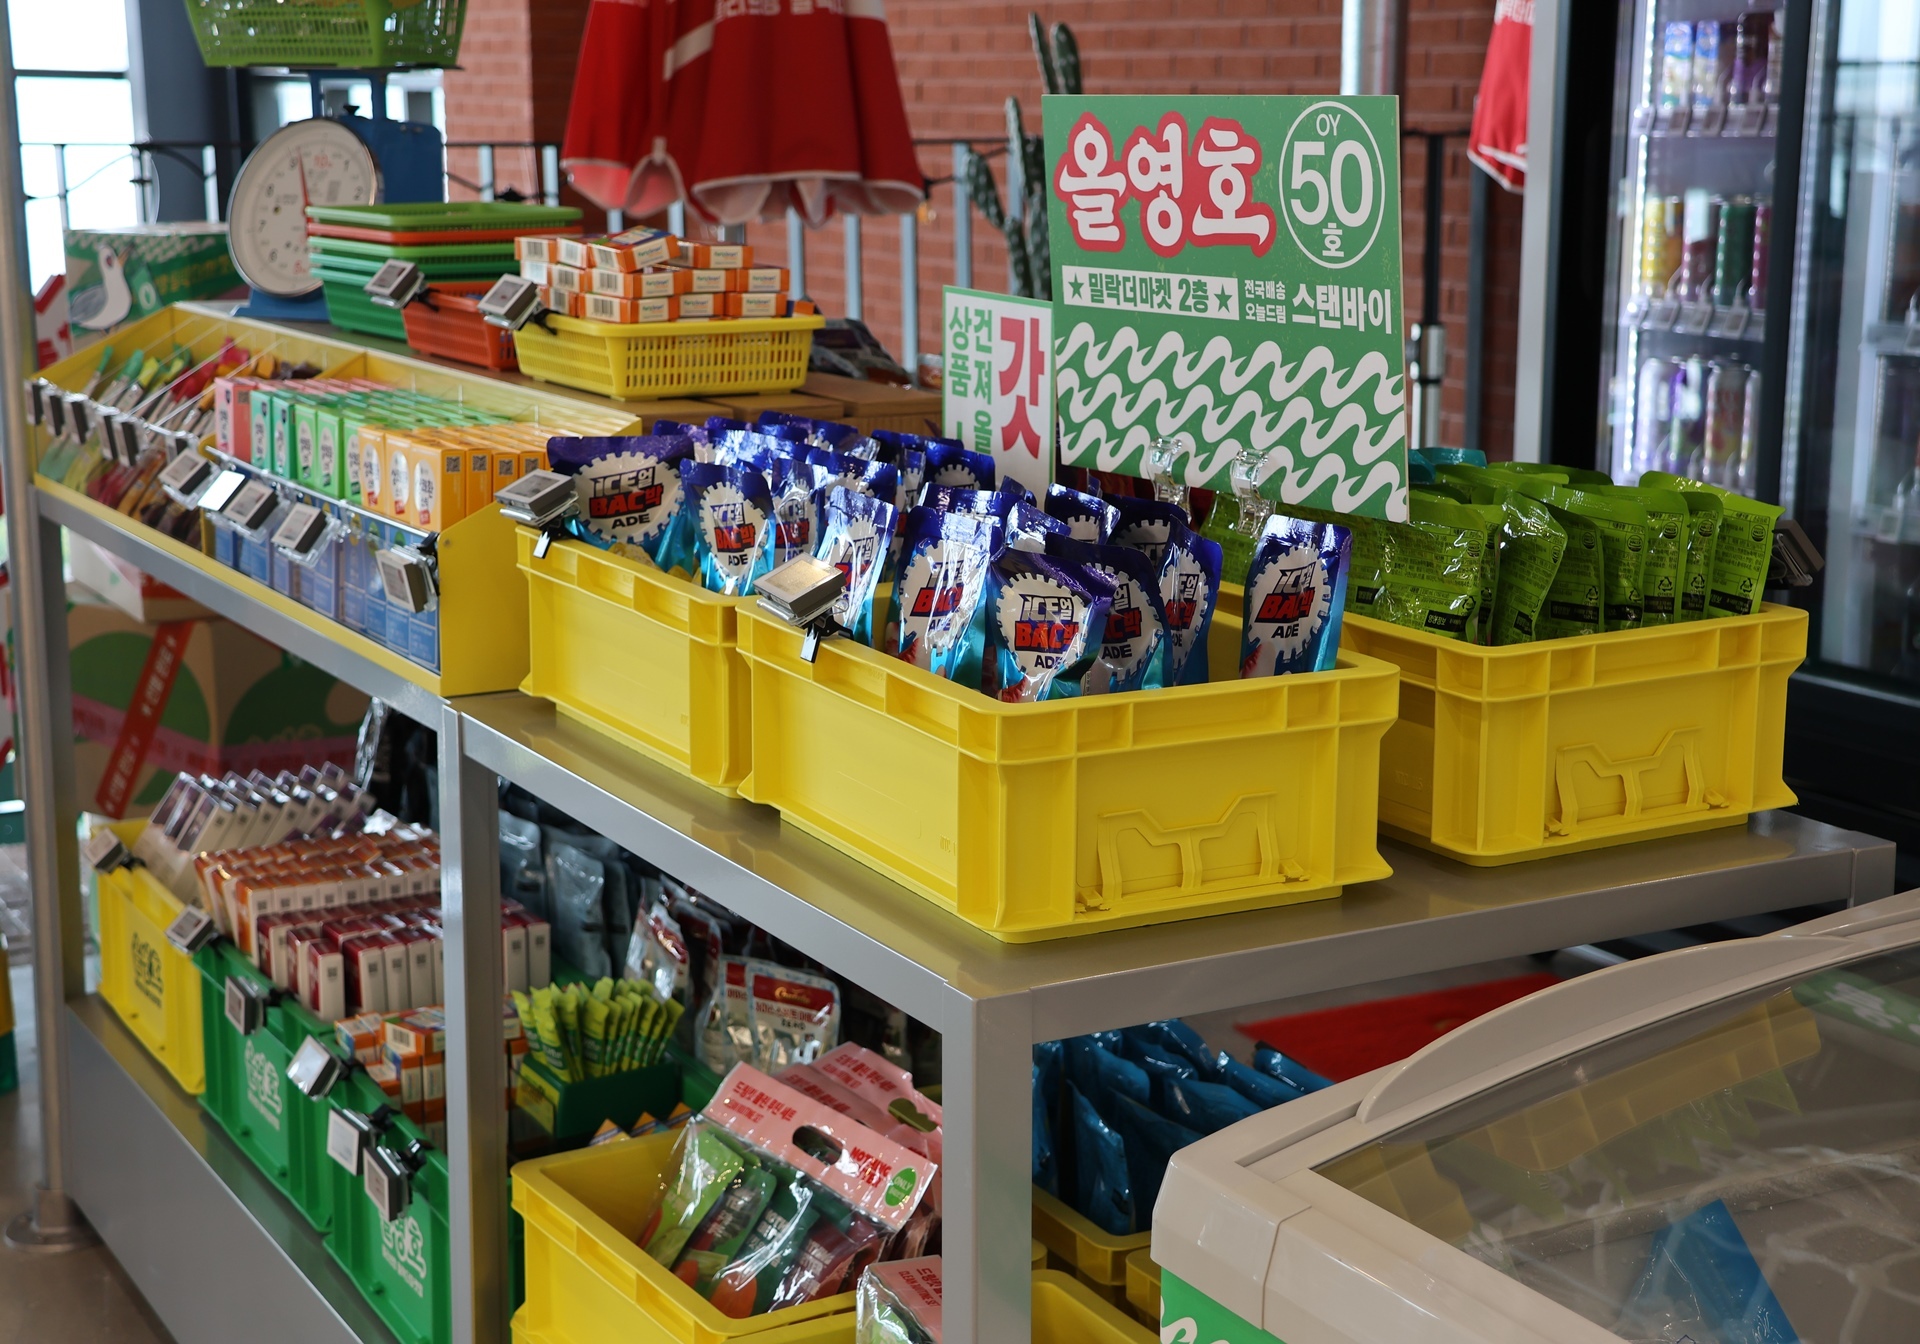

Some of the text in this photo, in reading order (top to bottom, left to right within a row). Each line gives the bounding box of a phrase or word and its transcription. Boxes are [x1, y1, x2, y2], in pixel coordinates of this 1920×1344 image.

[1316, 113, 1341, 136] OY
[1058, 120, 1271, 248] 올영호
[1290, 139, 1374, 228] 50
[1322, 222, 1344, 258] 호
[1088, 272, 1209, 313] 밀락더마켓 2층
[1244, 279, 1286, 301] 전국배송
[1245, 303, 1286, 325] 오늘드림
[1292, 283, 1392, 335] 스탠바이
[999, 316, 1045, 460] 갓
[611, 513, 651, 529] ADE
[1271, 624, 1300, 639] ADE
[1101, 644, 1132, 660] ADE
[893, 1176, 913, 1191] ONLY
